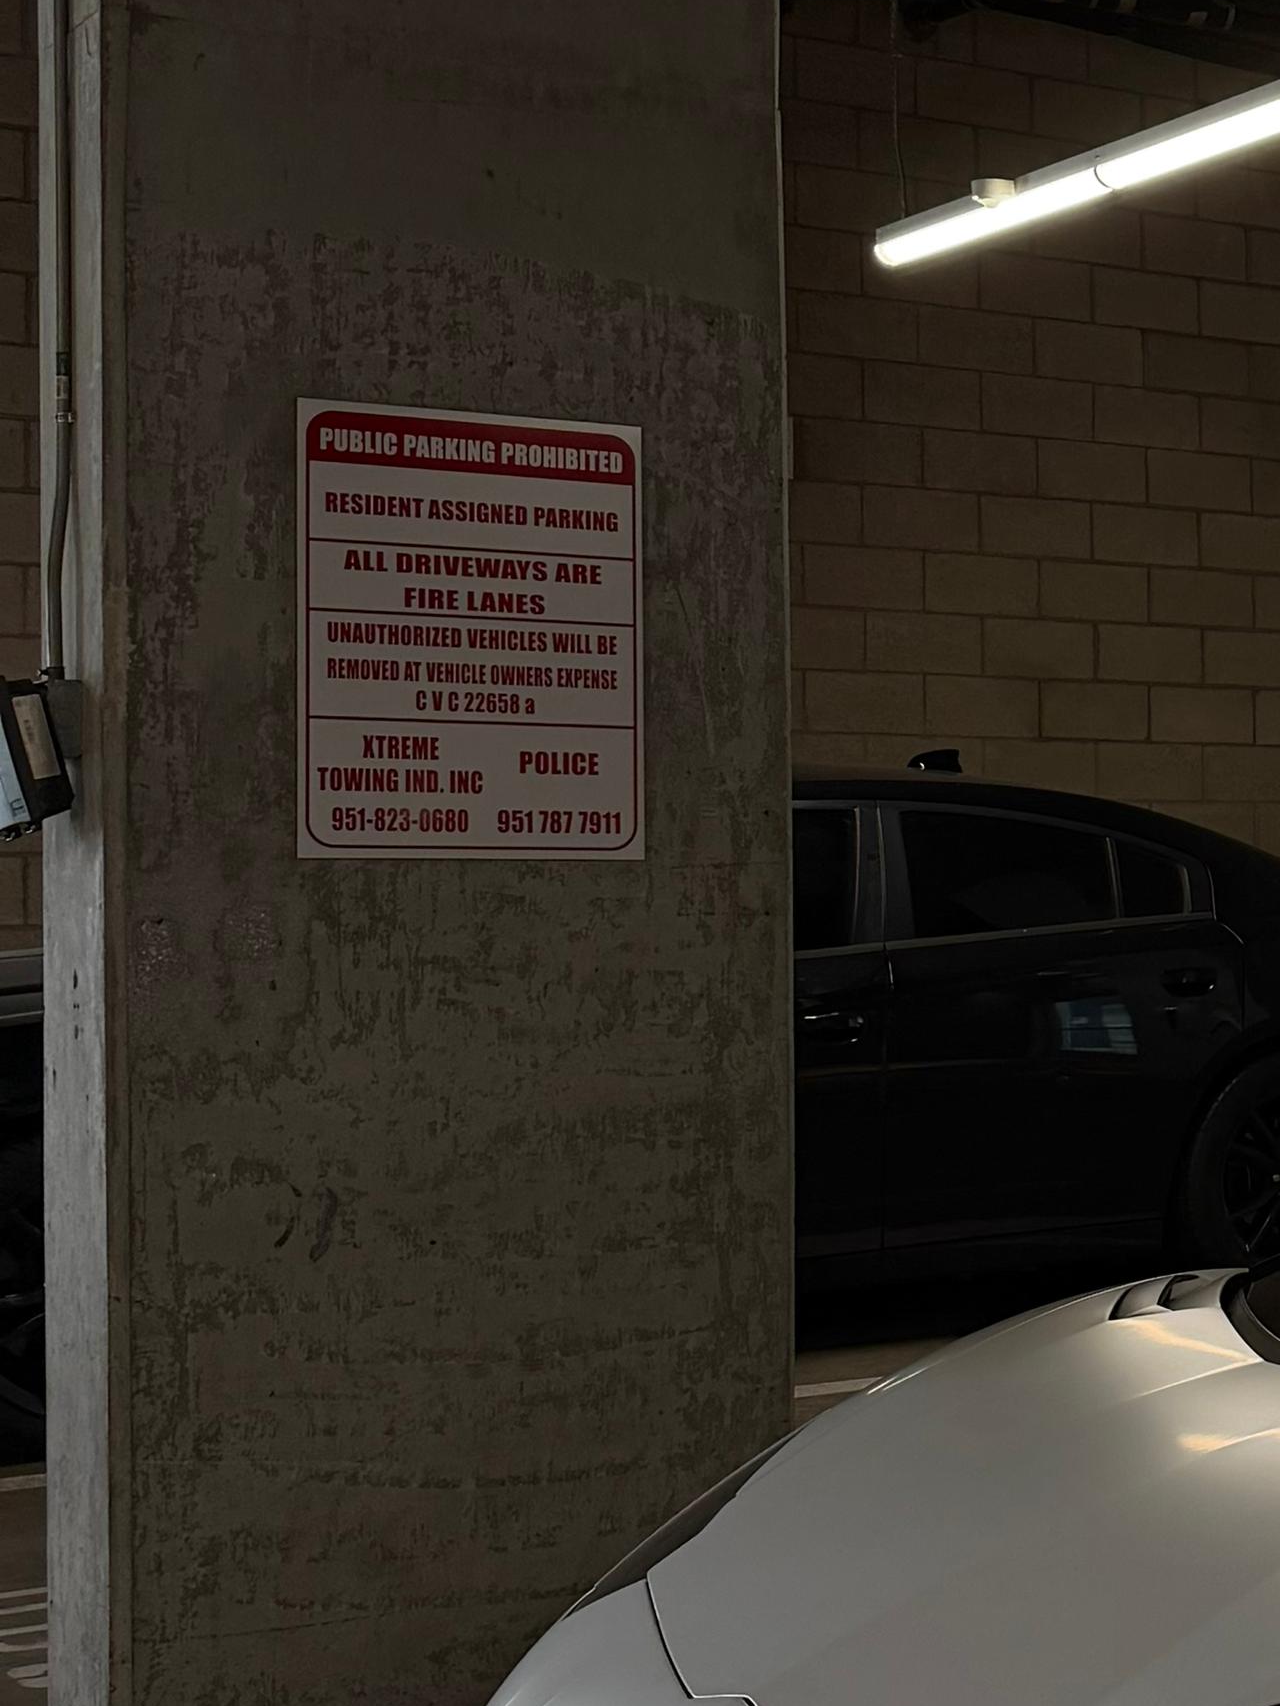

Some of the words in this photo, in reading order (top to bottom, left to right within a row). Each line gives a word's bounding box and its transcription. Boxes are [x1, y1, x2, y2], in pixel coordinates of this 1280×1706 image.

[320, 428, 397, 455] PUBLIC
[403, 434, 495, 464] PARKING
[502, 443, 623, 474] PROHIBITED
[325, 492, 424, 517] RESIDENT
[428, 500, 527, 526] ASSIGNED
[534, 507, 618, 532] PARKING
[344, 550, 387, 571] ALL
[397, 553, 547, 582] DRIVEWAYS
[555, 564, 602, 585] ARE
[404, 588, 458, 610] FIRE
[467, 593, 545, 615] LANES
[327, 622, 461, 648] UNAUTHORIZED
[467, 631, 547, 652] VEHICLES
[552, 634, 591, 654] WILL
[597, 636, 617, 655] BE
[327, 659, 399, 681] REMOVED
[404, 662, 420, 681] AT
[426, 662, 486, 685] VEHICLE
[491, 665, 552, 687] OWNERS
[557, 668, 617, 690] EXPENSE
[463, 692, 520, 713] 22658
[363, 735, 439, 760] XTREME
[519, 752, 598, 775] POLICE
[318, 767, 398, 793] TOWING
[405, 769, 444, 794] IND.
[450, 771, 483, 794] INC
[332, 808, 469, 833] 951-823-0680
[497, 810, 534, 834] 951
[540, 812, 572, 834] 787
[578, 812, 621, 834] 7911
